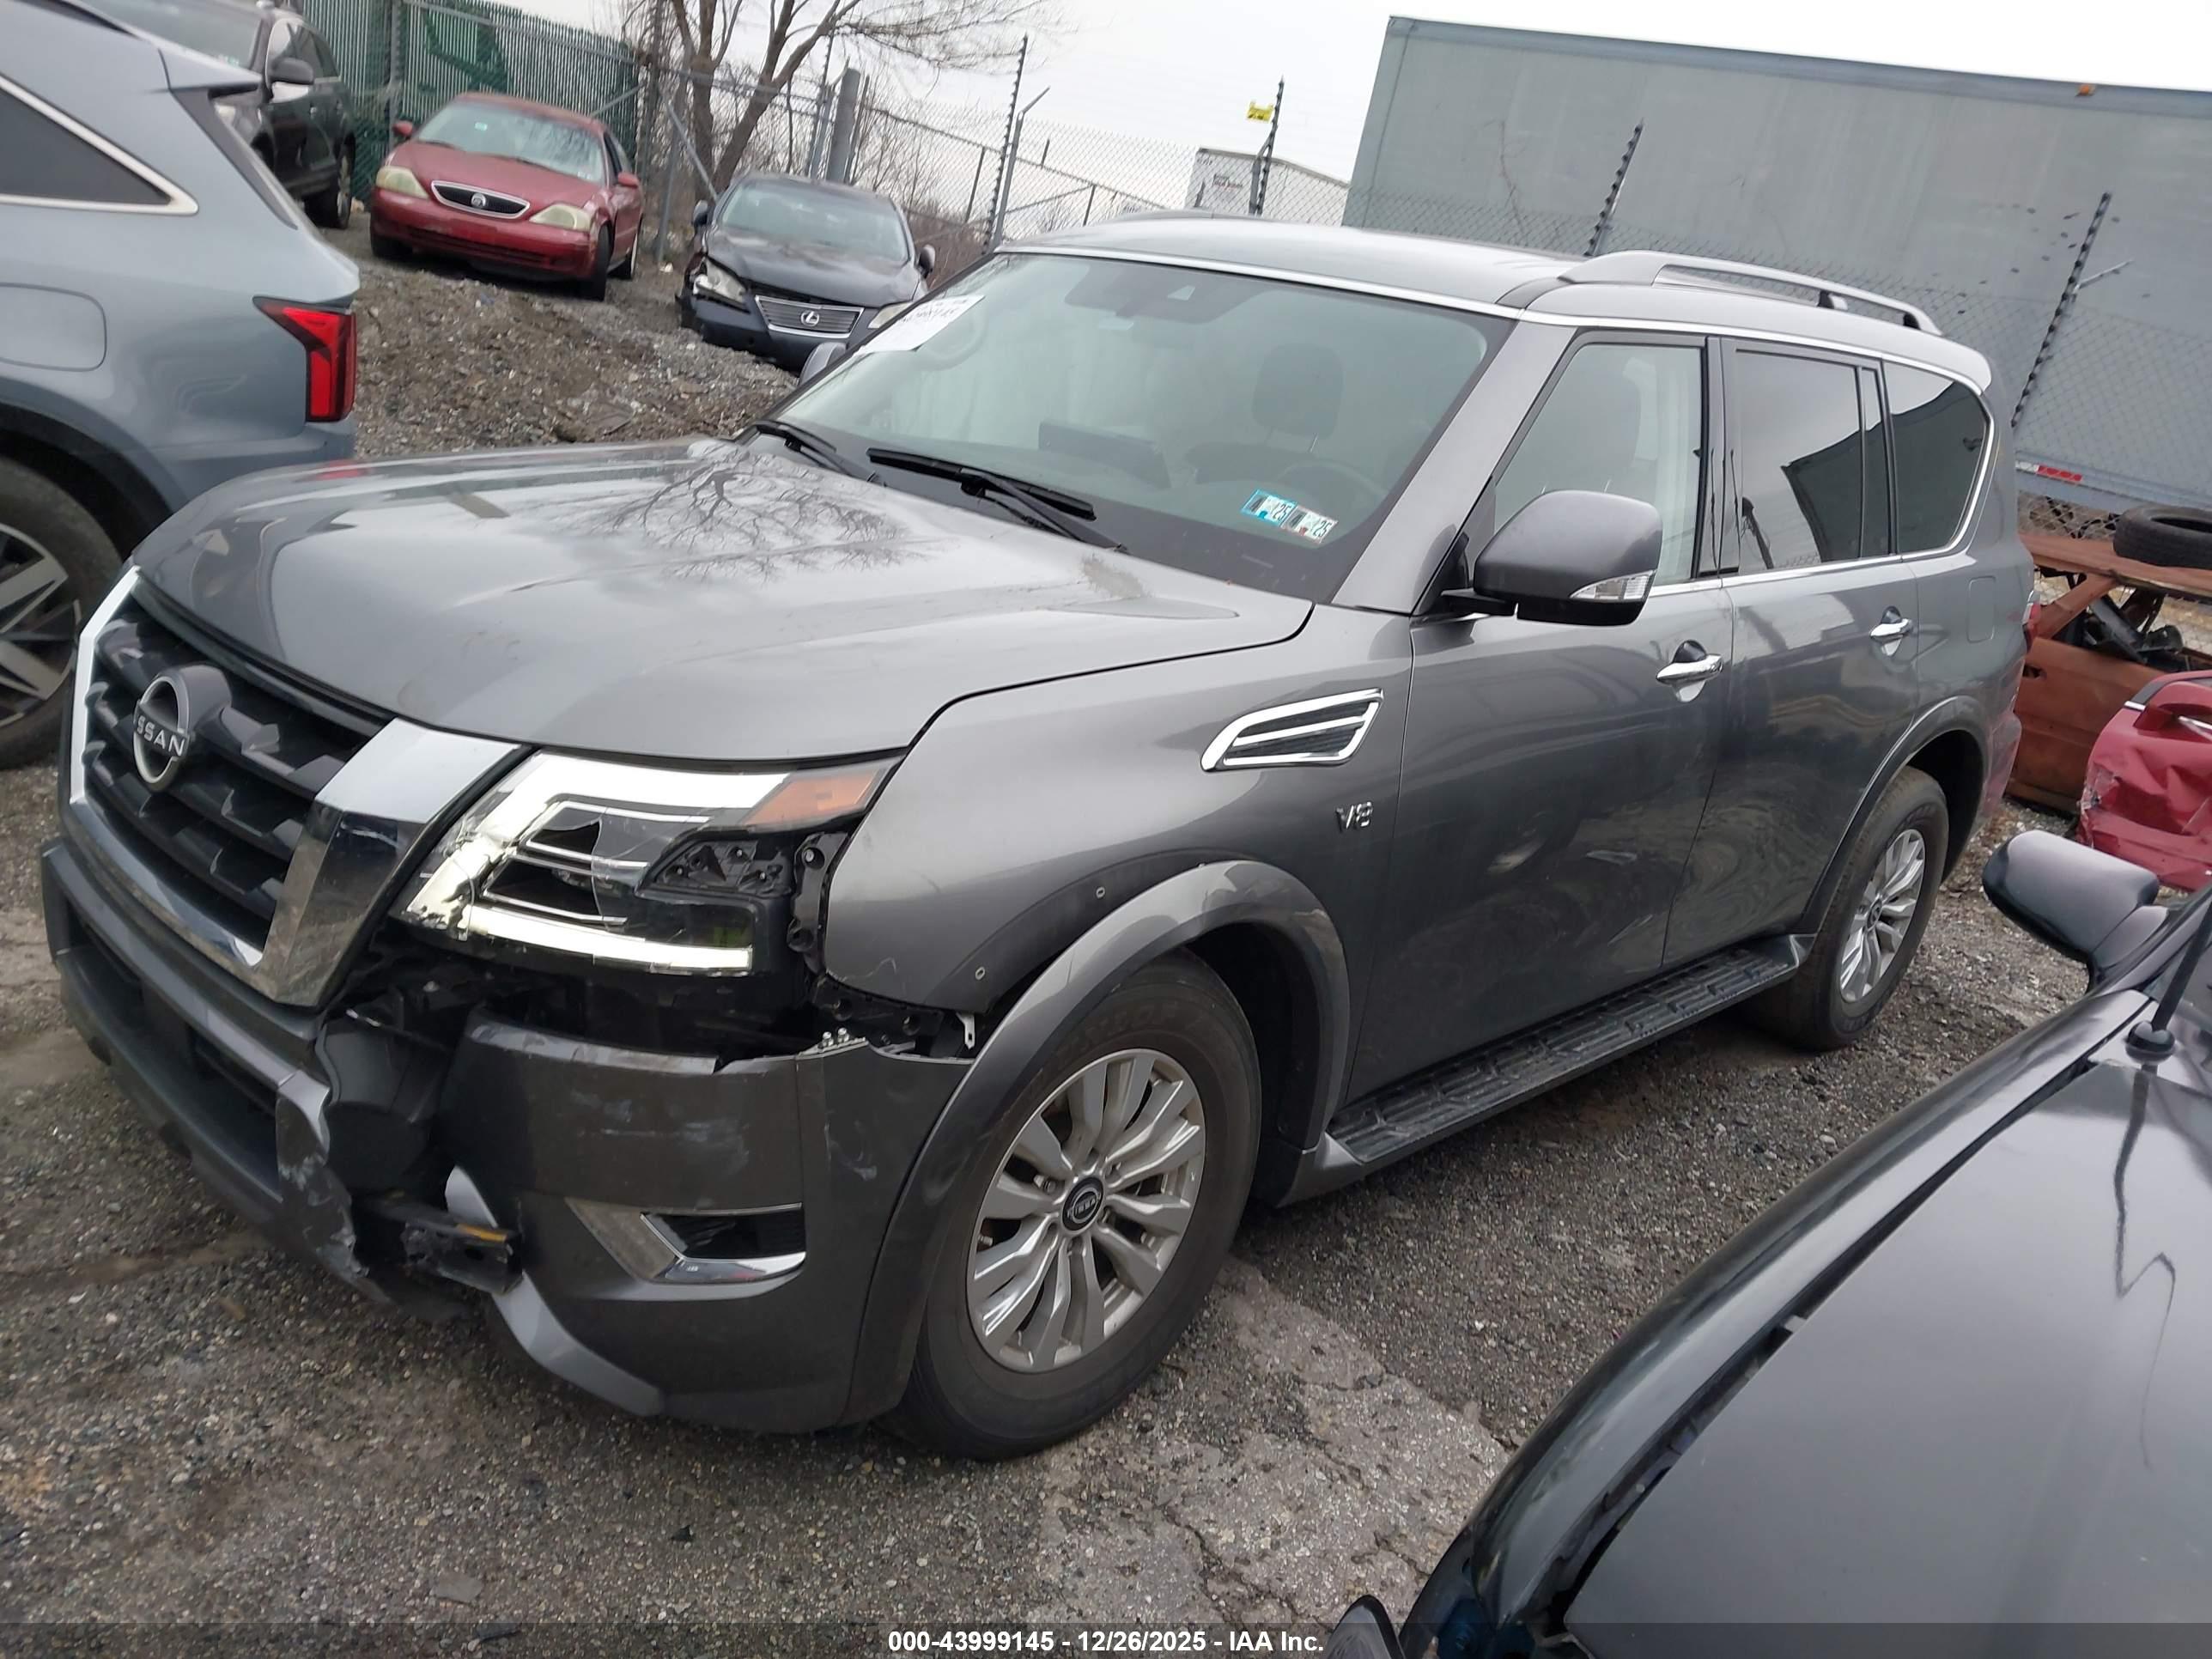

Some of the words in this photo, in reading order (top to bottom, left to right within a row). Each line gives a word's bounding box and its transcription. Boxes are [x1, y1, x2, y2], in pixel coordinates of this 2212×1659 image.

[1272, 503, 1292, 522] 25
[1312, 520, 1333, 538] 25
[1336, 801, 1373, 830] V8
